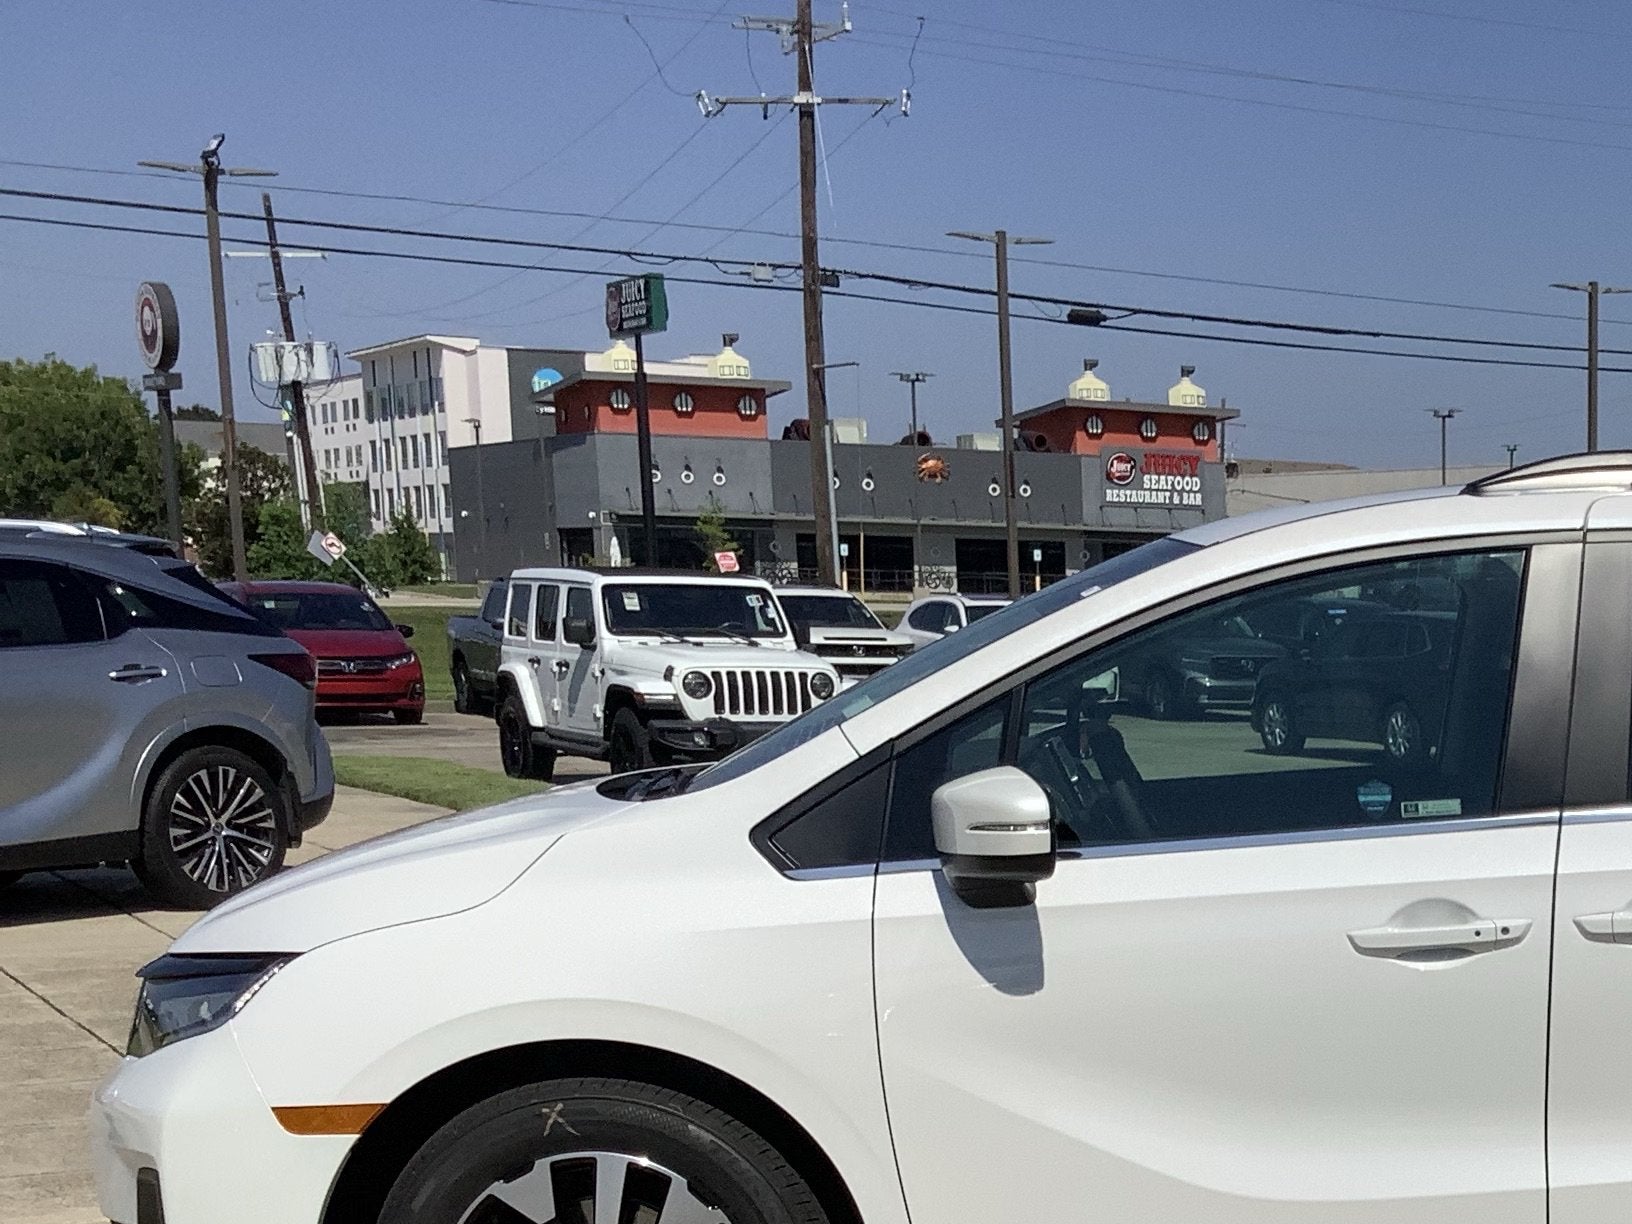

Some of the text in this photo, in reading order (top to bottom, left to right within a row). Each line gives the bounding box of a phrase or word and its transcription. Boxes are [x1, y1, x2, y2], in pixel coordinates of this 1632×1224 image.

[621, 279, 645, 303] JUICY
[1140, 452, 1200, 477] JUICY
[1143, 474, 1201, 491] SEAFOOD
[1105, 489, 1203, 506] RESTAURANT & BAR
